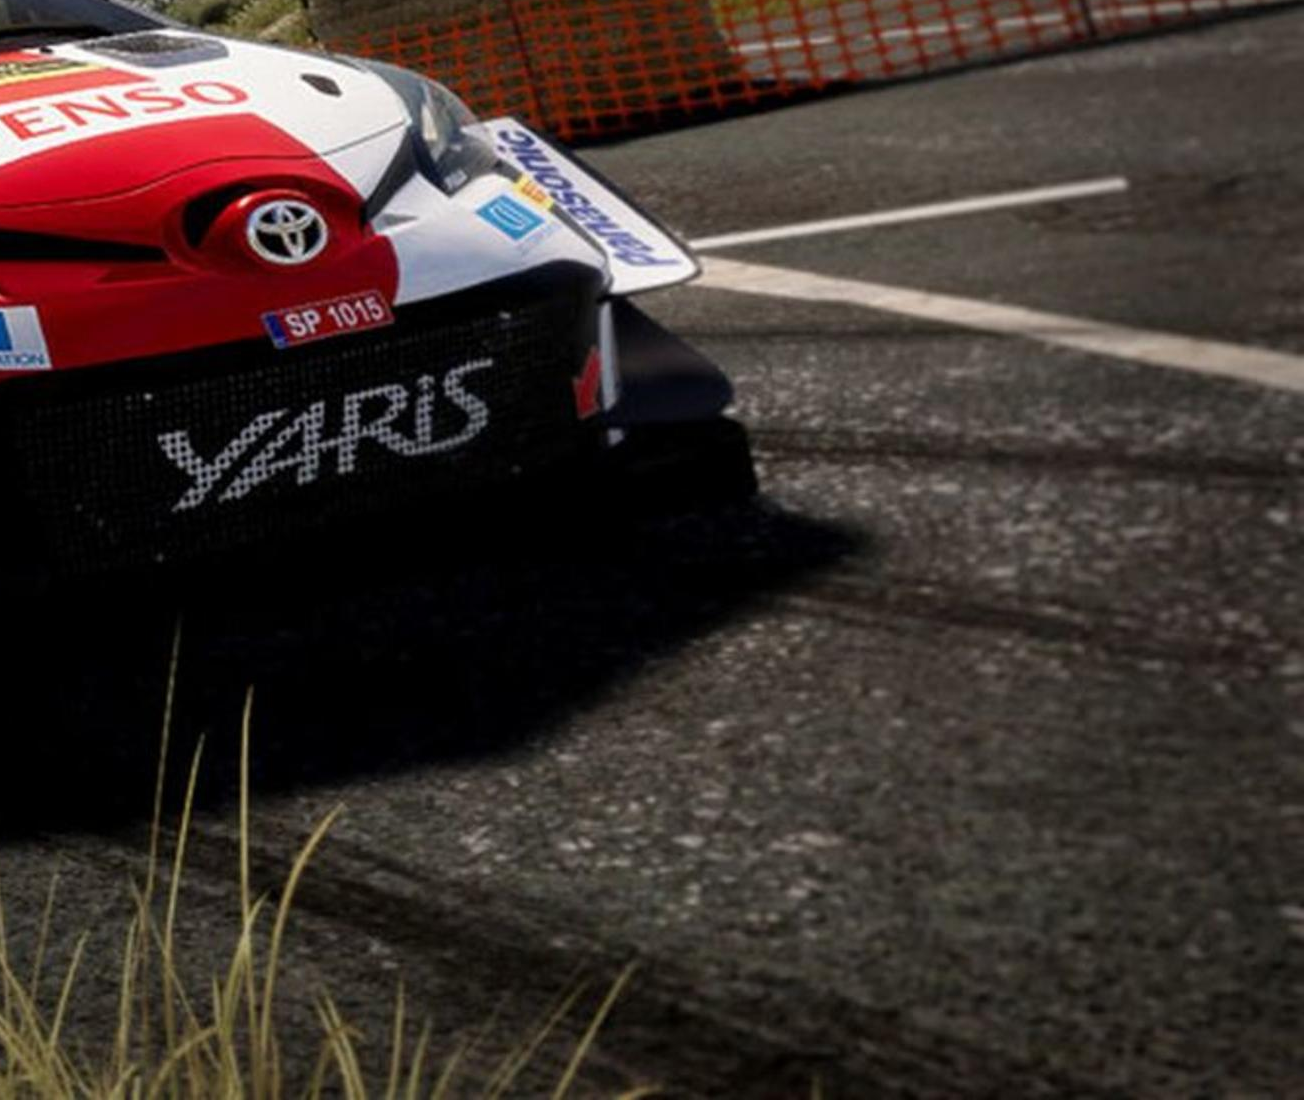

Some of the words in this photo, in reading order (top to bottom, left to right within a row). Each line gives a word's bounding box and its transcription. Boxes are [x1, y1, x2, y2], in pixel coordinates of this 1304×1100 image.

[498, 130, 682, 267] Panasonic
[285, 311, 321, 338] SP
[327, 297, 385, 329] 1015
